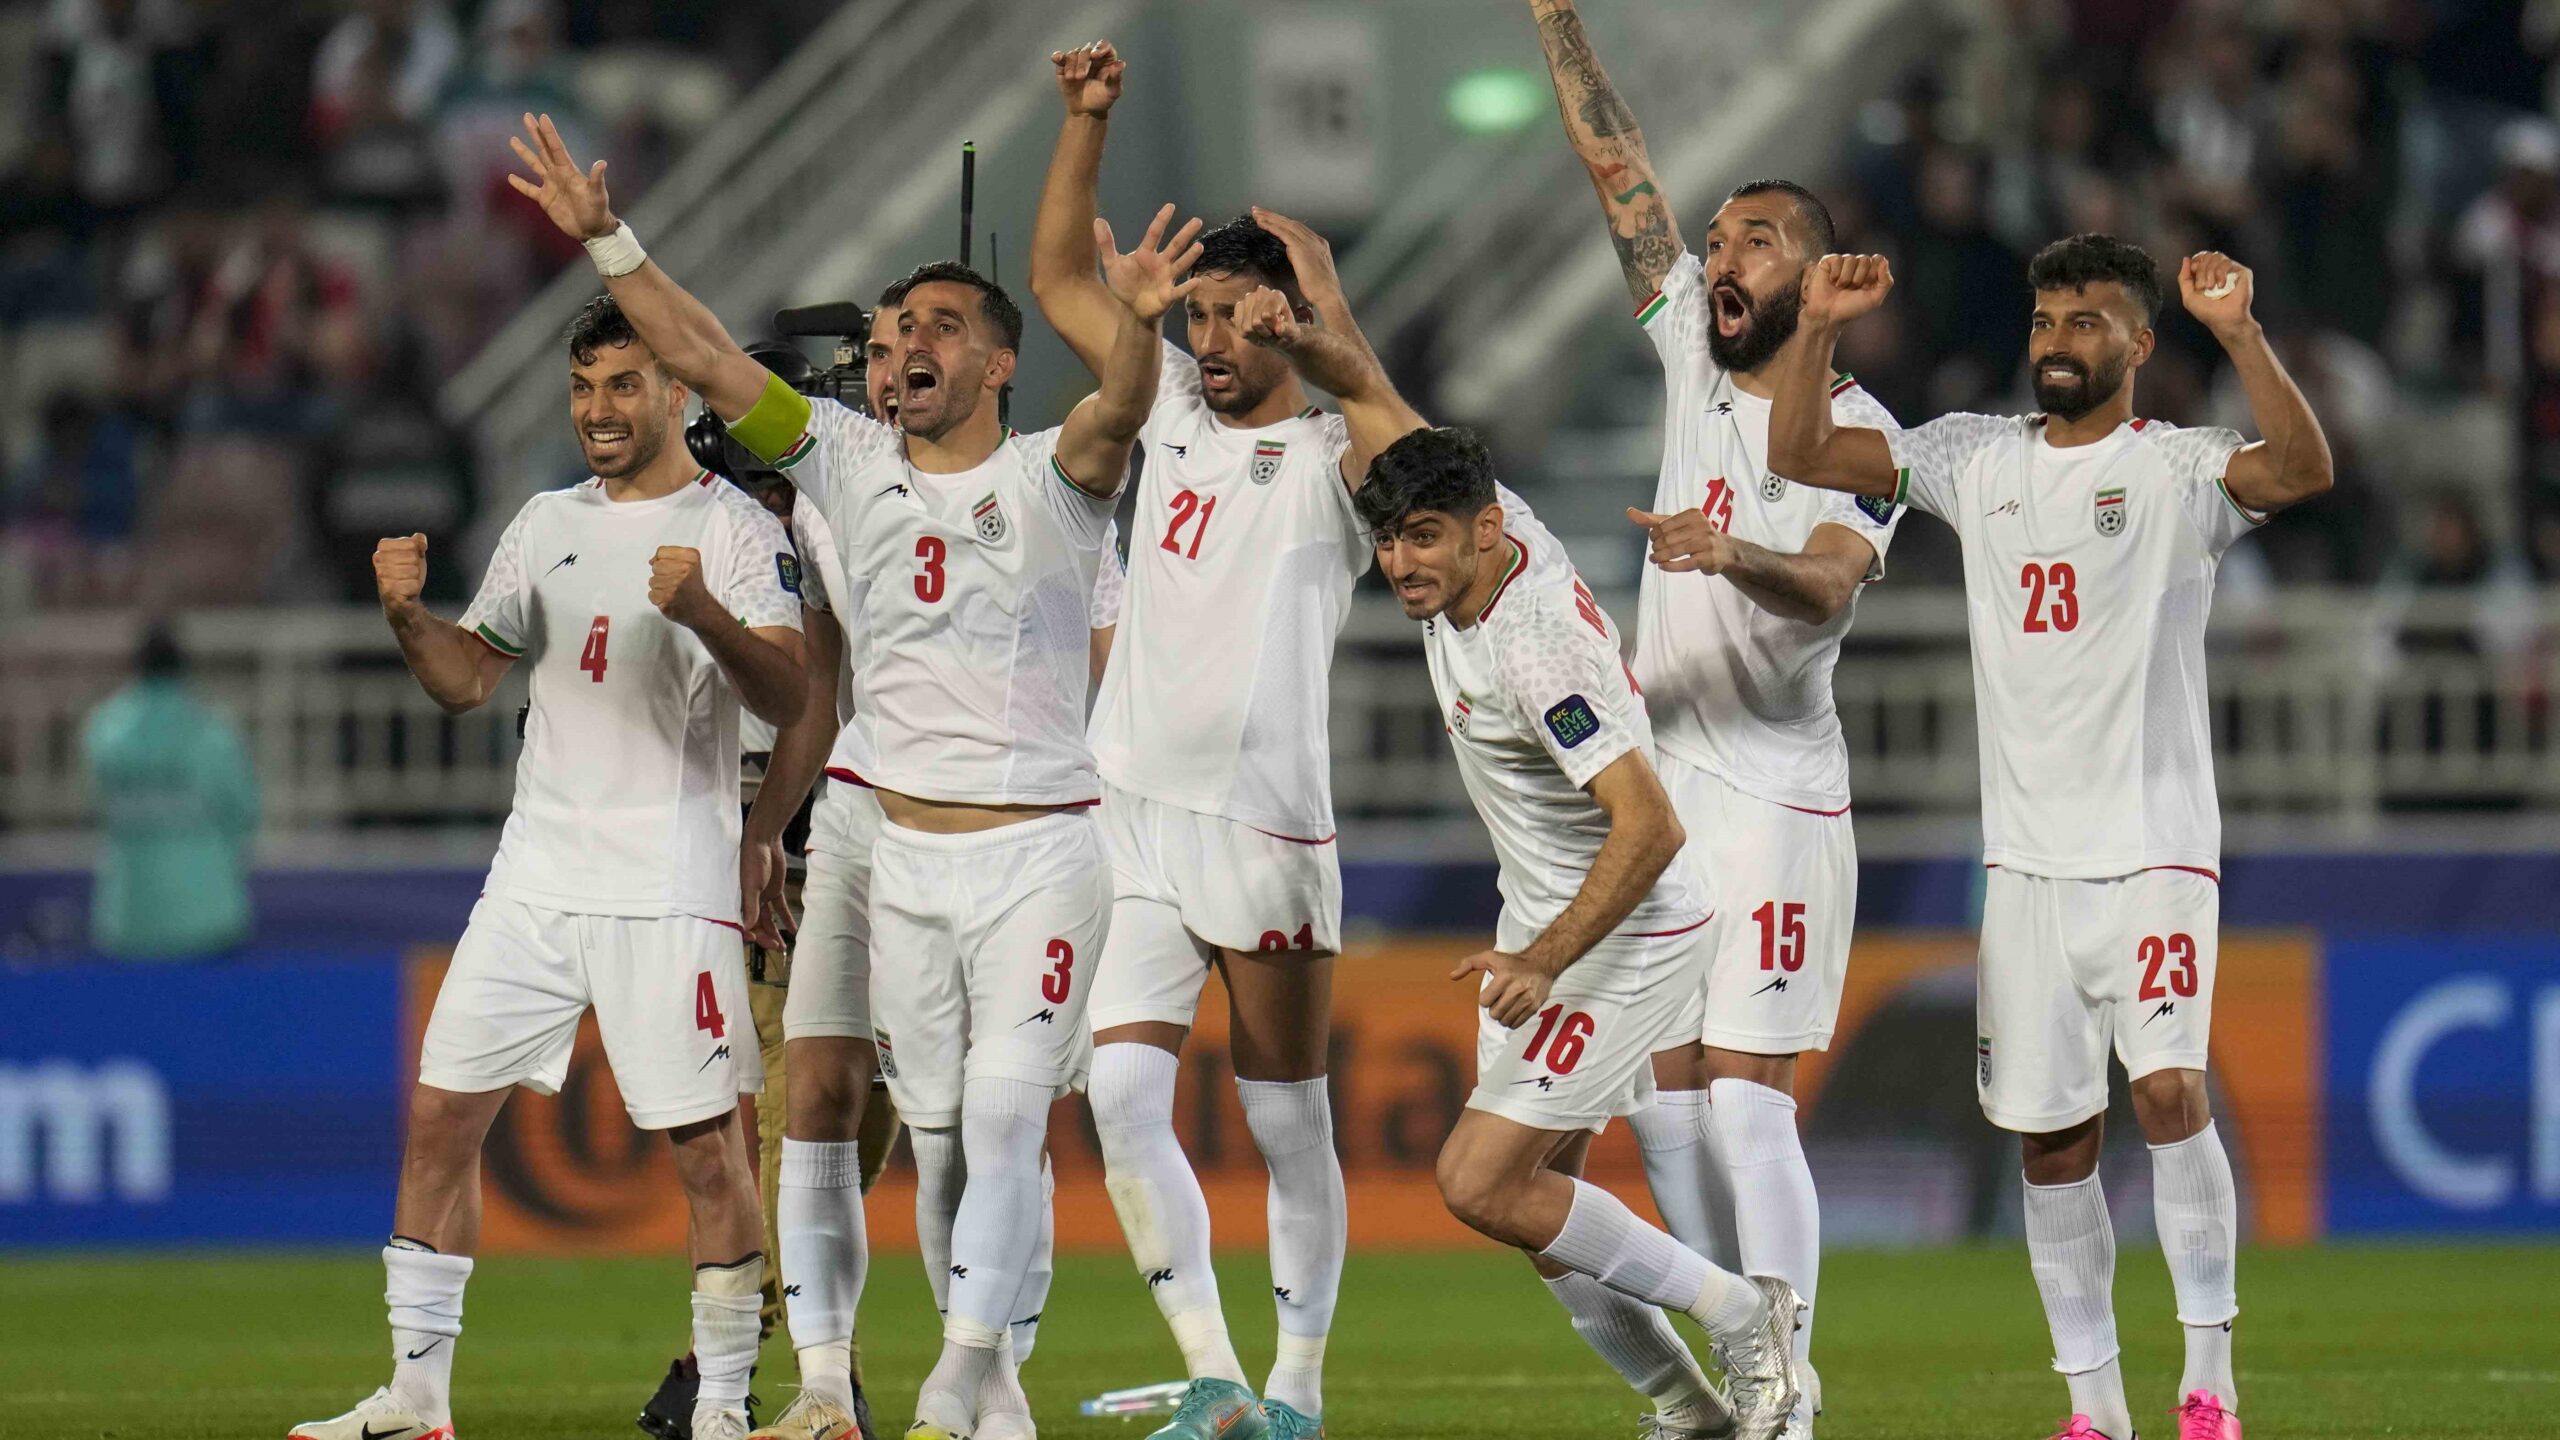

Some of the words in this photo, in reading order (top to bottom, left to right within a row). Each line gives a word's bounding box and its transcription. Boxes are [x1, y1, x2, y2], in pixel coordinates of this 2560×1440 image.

[1160, 489, 1217, 560] 21
[1701, 476, 1735, 535] 15
[914, 536, 946, 603] 3
[2020, 562, 2079, 633] 23
[580, 616, 608, 683] 4
[1552, 708, 1569, 724] AFC
[1555, 707, 1586, 733] LIVE
[1751, 901, 1806, 971] 15
[2137, 933, 2198, 1002] 23
[696, 970, 725, 1039] 4
[1041, 938, 1074, 1004] 3
[1521, 1003, 1595, 1075] 16
